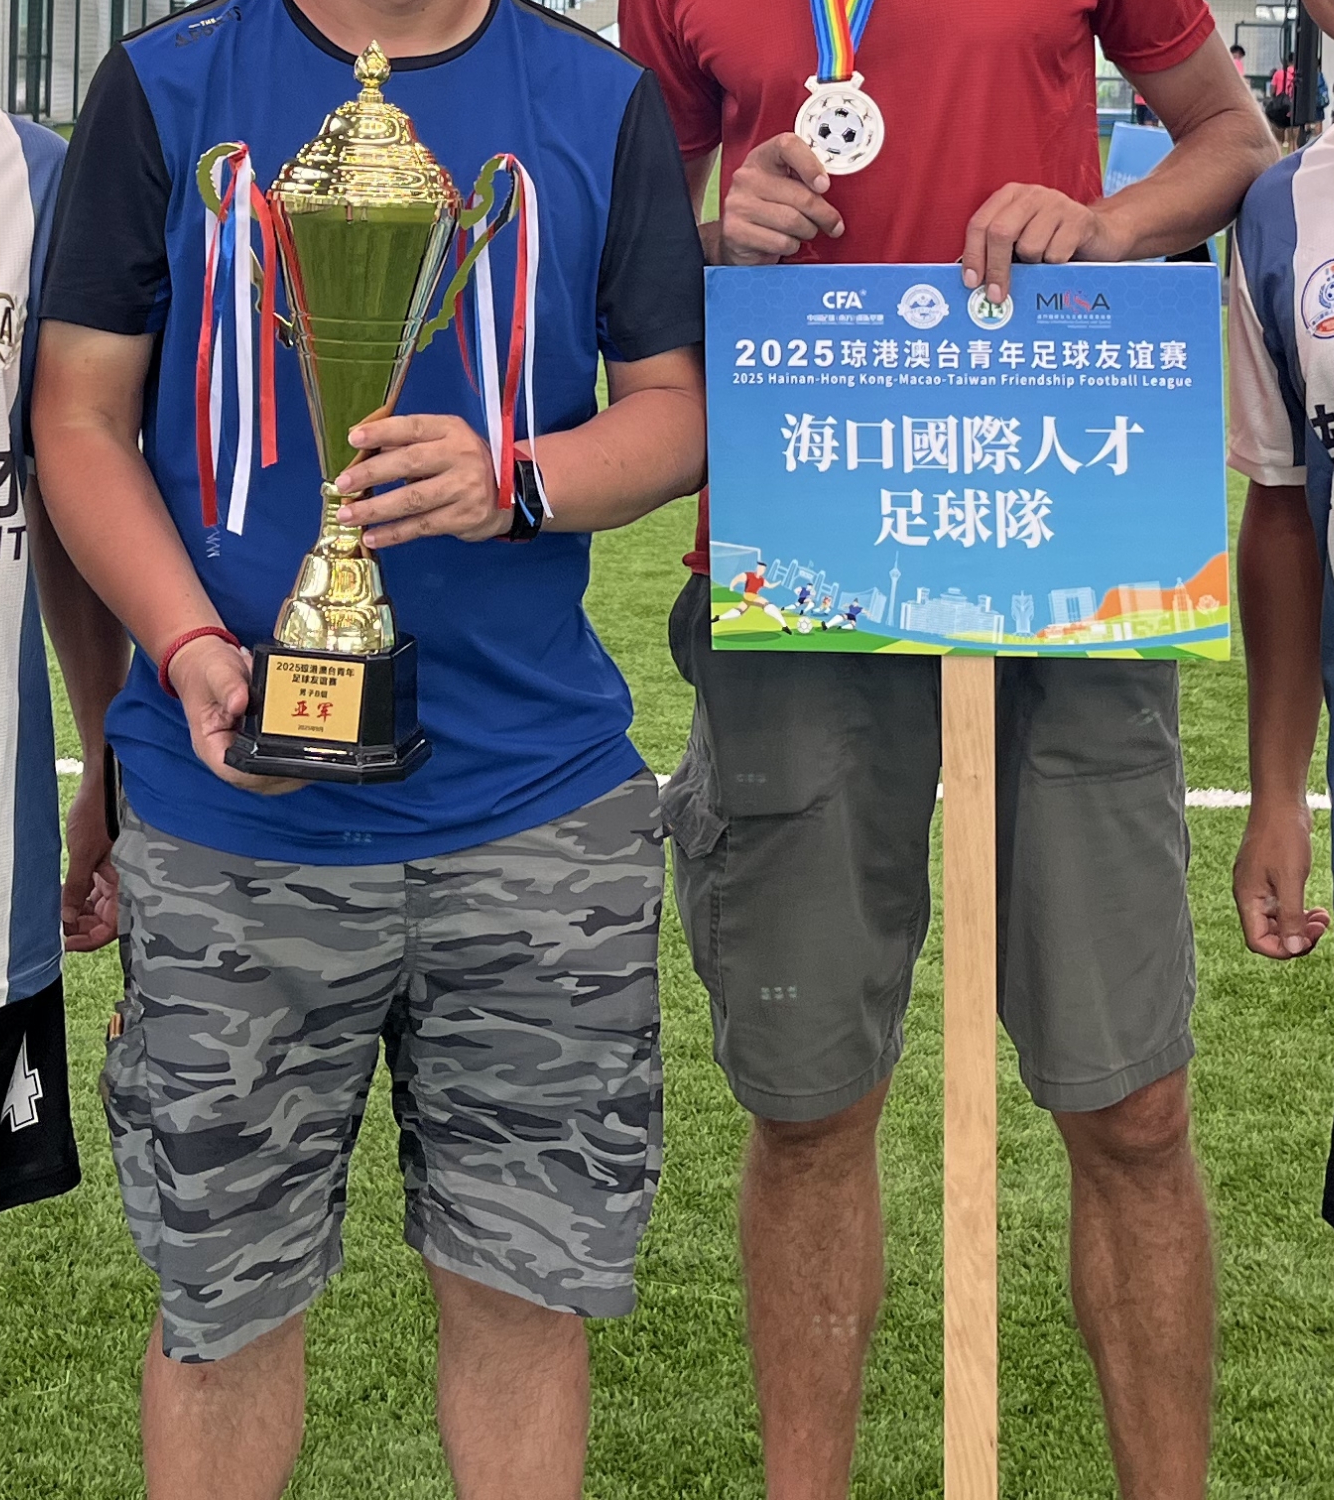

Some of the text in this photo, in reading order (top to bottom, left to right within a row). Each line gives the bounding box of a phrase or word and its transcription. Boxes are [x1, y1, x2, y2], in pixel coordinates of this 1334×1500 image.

[822, 291, 863, 309] CFA
[734, 338, 1188, 370] 2025琼港澳台青年足球友谊赛
[732, 372, 1193, 390] 2025 Hainan-Hong Kong-Macao-Taiwan Friendship Football League
[781, 412, 1145, 476] 海口國際人才
[874, 488, 1055, 549] 足球隊
[291, 700, 334, 723] 亚军
